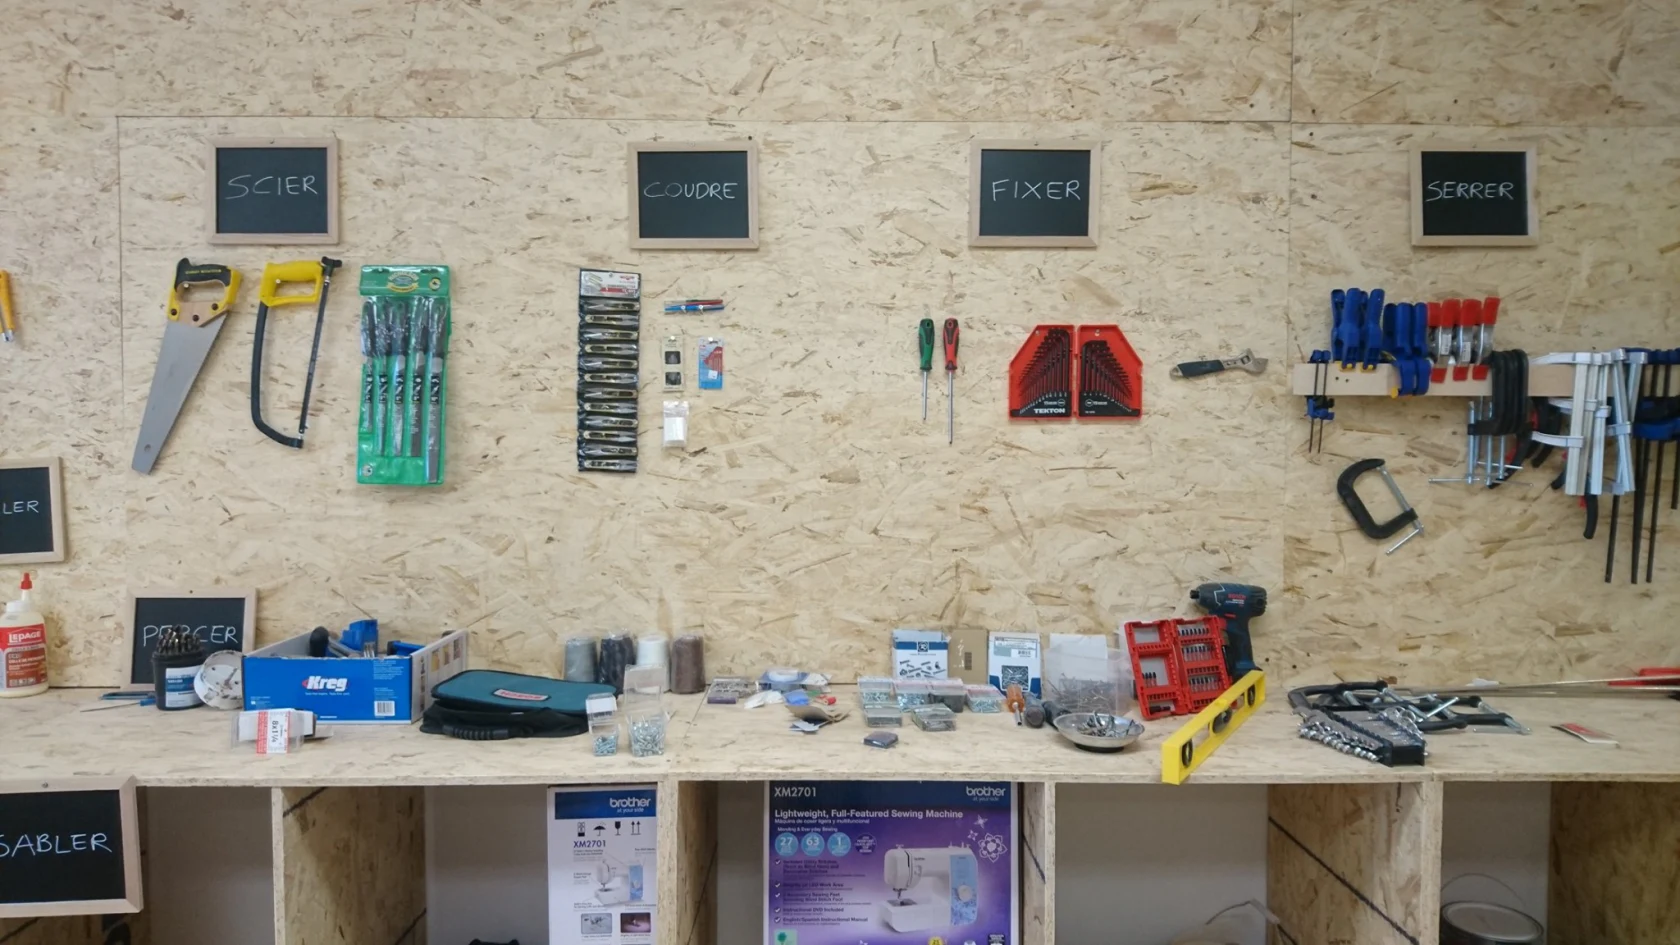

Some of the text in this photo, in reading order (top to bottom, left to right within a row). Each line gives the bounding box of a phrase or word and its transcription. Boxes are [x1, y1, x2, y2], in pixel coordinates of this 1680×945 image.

[225, 174, 318, 200] SCIER
[643, 182, 738, 201] COUDRE
[991, 178, 1081, 202] FIXER
[1425, 180, 1514, 202] SERRER
[307, 676, 348, 692] Kreg
[774, 786, 817, 797] XM2701
[965, 786, 1006, 797] brother
[609, 797, 651, 808] brother
[774, 809, 964, 819] Lightweight, Full-Featured Sewing Machine
[573, 840, 606, 848] XM2701
[780, 837, 793, 845] 27
[806, 837, 820, 845] 63
